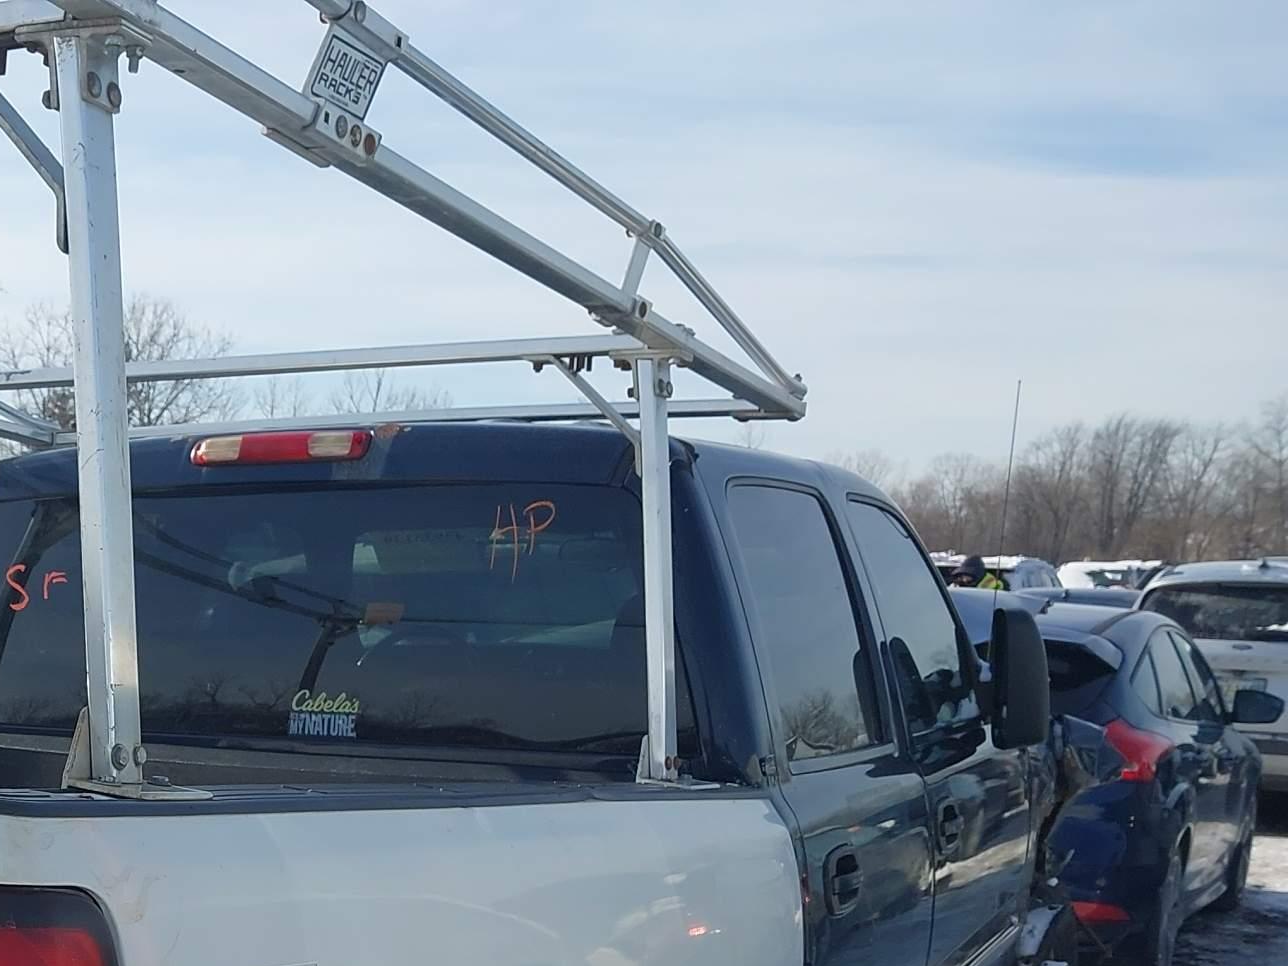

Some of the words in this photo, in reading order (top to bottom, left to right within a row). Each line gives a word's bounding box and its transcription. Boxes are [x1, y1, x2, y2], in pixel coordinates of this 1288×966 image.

[323, 45, 378, 95] HAULER
[318, 72, 362, 105] RACKS
[490, 501, 556, 584] HP
[292, 689, 360, 713] Cabela's
[304, 712, 357, 737] NATURE
